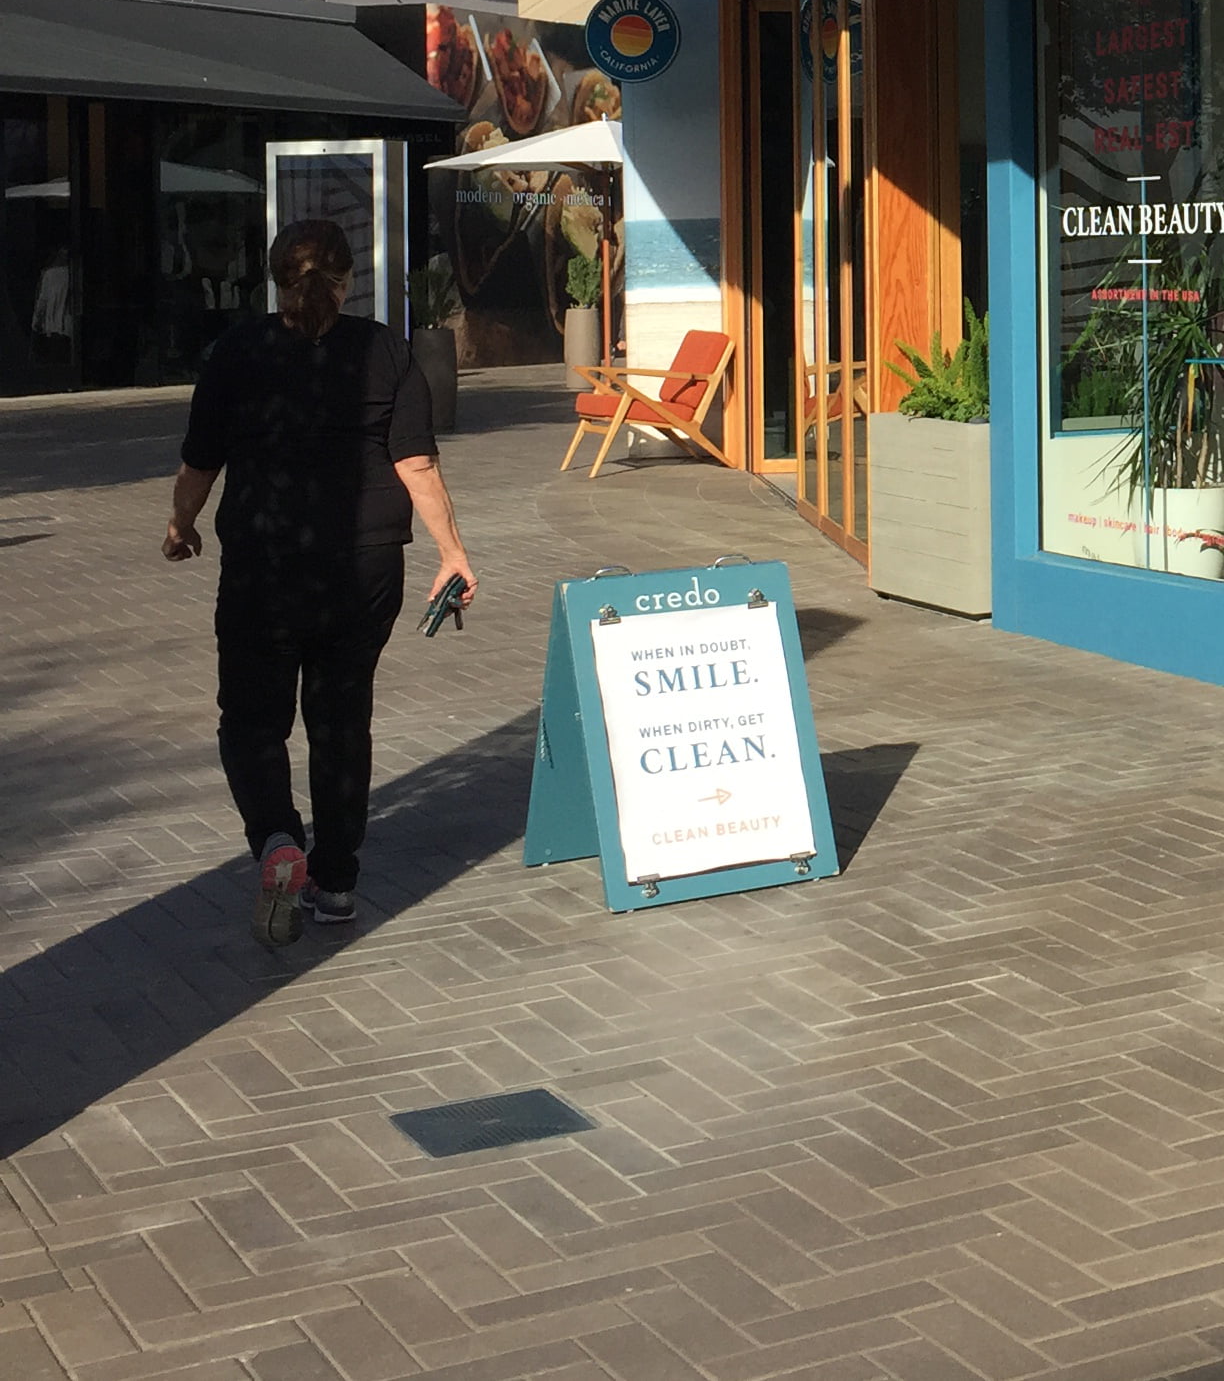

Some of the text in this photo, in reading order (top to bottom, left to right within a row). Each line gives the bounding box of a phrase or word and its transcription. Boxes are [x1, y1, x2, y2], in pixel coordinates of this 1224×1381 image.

[643, 1, 671, 33] LAYER
[1095, 19, 1189, 57] LARGEST
[600, 49, 658, 73] CALIFORNIA
[1104, 71, 1183, 104] SAFEST
[1094, 120, 1195, 155] REAL-EST
[455, 185, 502, 203] modern
[512, 186, 557, 211] organic
[1062, 205, 1134, 237] CLEAN
[1091, 288, 1147, 301] ASSORTMENT
[1162, 289, 1179, 301] THE
[1182, 289, 1200, 302] USA
[1068, 512, 1097, 527] makeup
[1104, 515, 1137, 532] skincare
[635, 576, 720, 611] credo
[631, 638, 751, 662] WHEN IN DOUBT,
[634, 659, 759, 697] SMILE.
[639, 713, 765, 739] WHEN DIRTY, GET
[640, 734, 776, 775] CLEAN.
[652, 815, 781, 846] CLEAN BEAUTY
